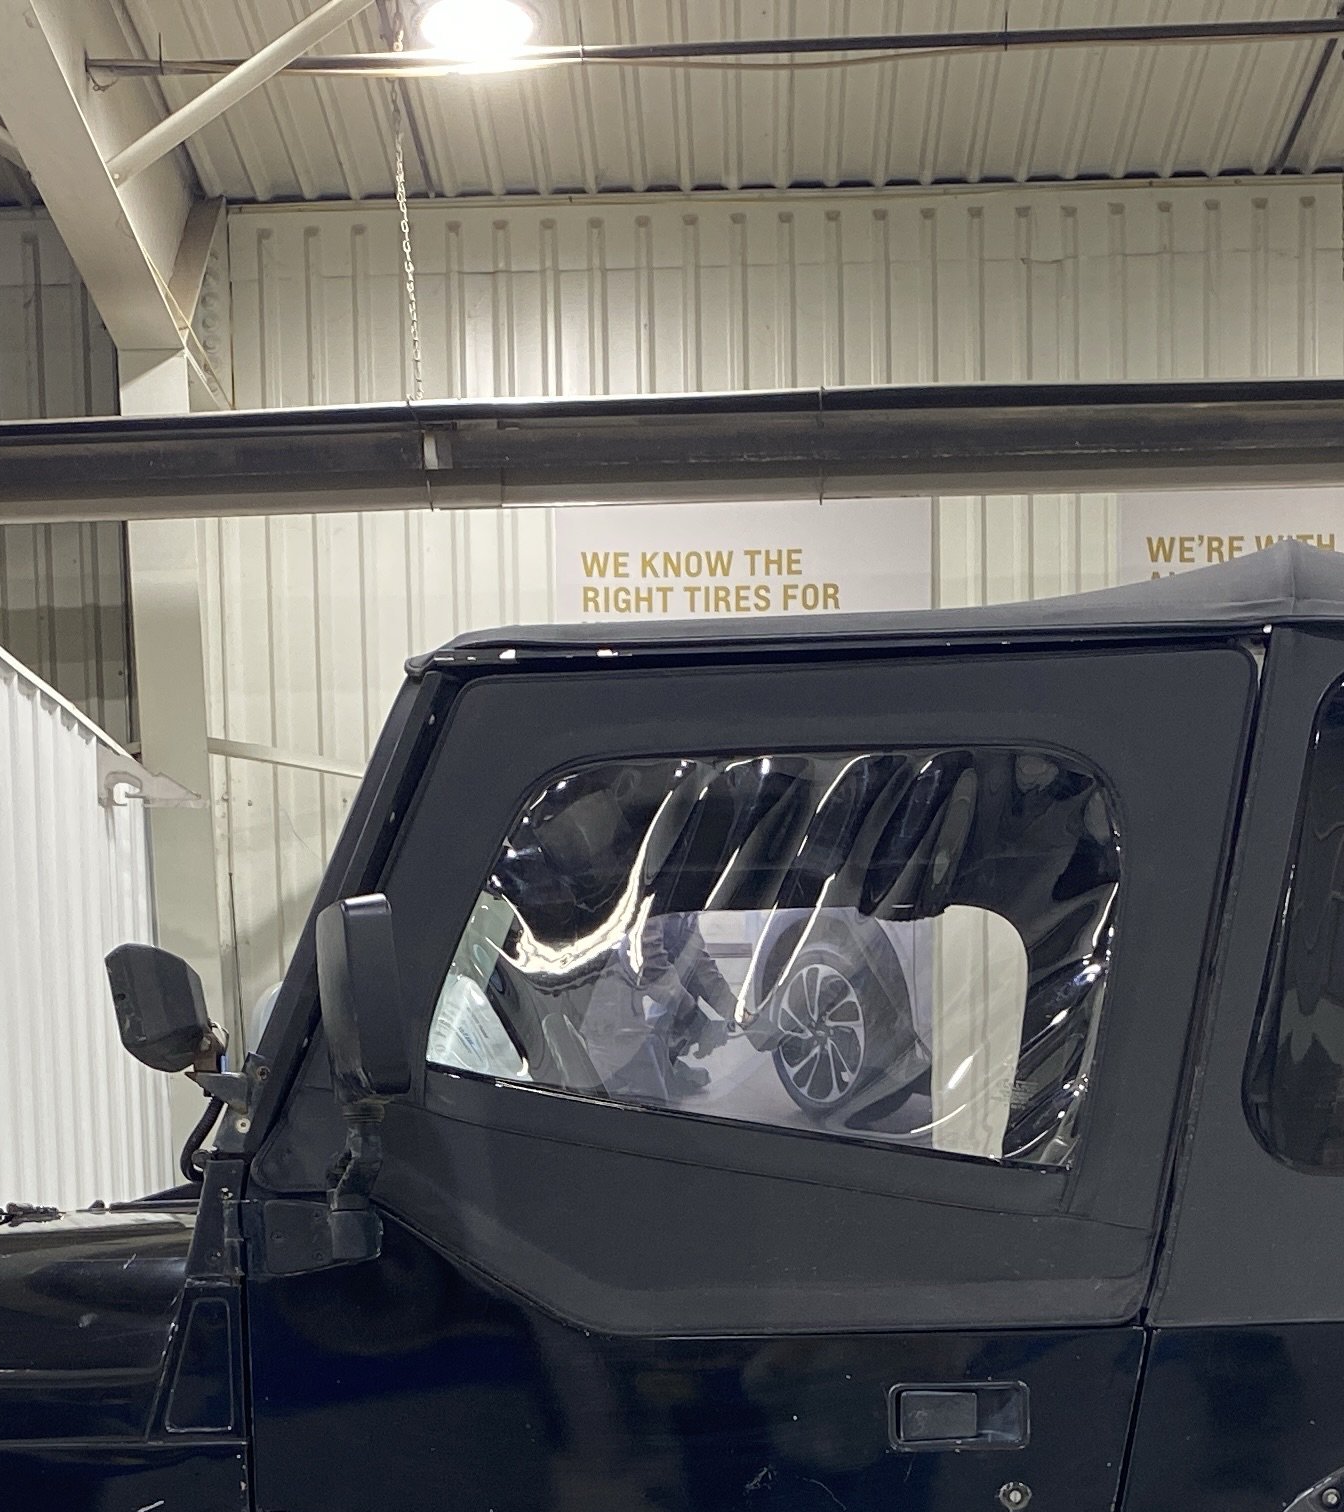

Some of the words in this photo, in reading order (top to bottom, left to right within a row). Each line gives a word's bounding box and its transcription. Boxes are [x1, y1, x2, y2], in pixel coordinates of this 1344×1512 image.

[581, 551, 630, 578] WE
[640, 551, 734, 578] KNOW
[744, 548, 803, 576] THE
[582, 586, 674, 613] RIGHT
[684, 584, 771, 612] TIRES
[783, 583, 841, 610] FOR
